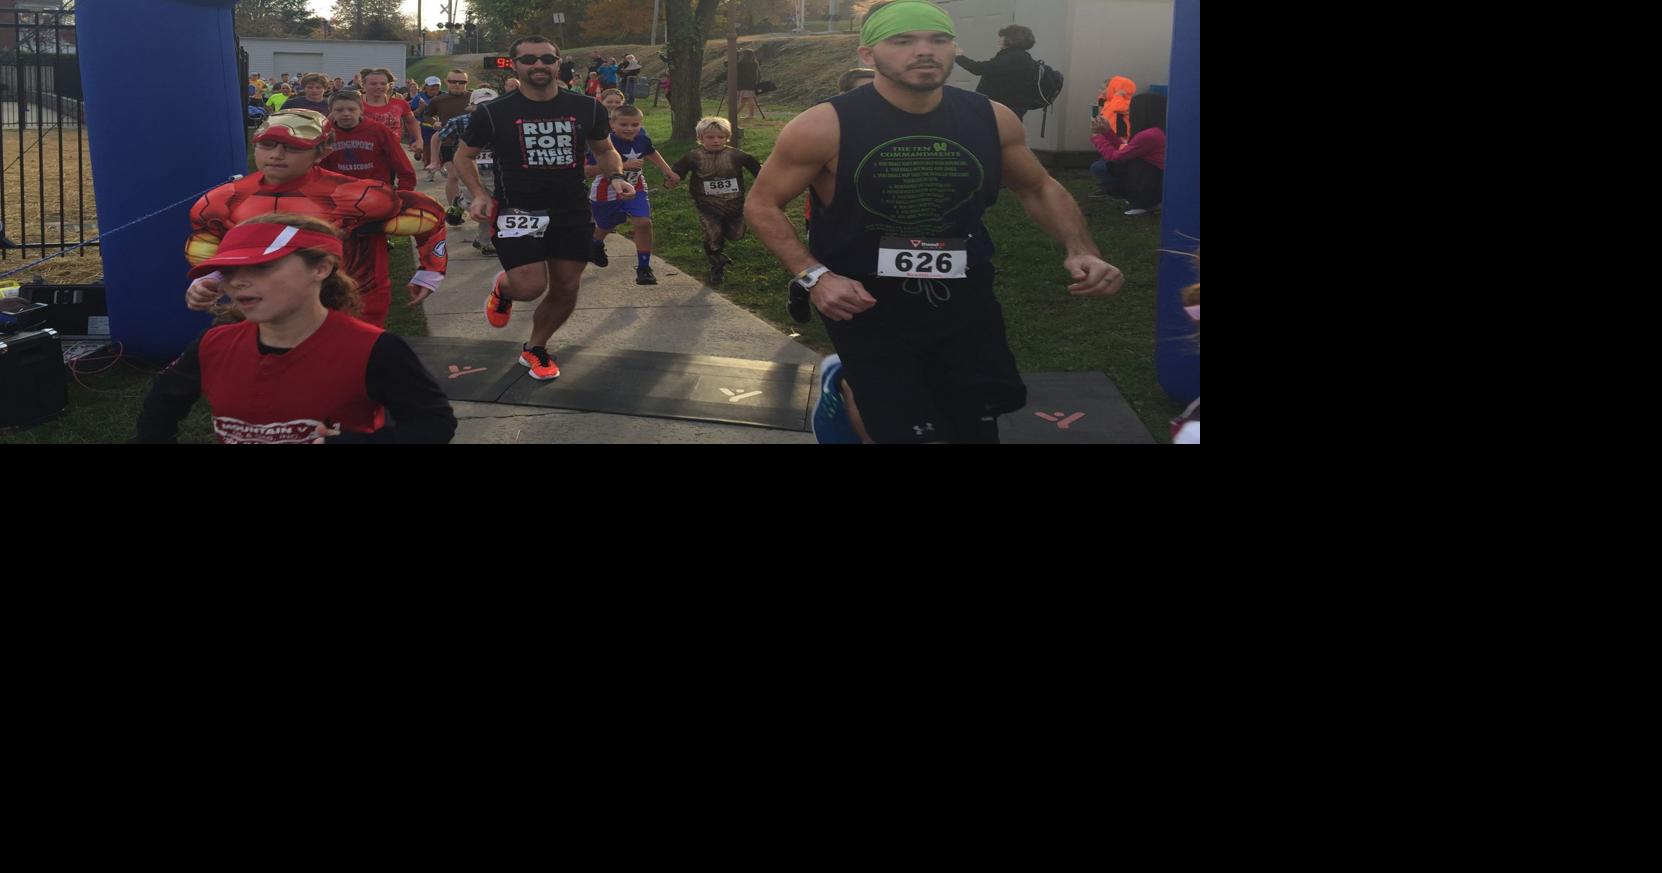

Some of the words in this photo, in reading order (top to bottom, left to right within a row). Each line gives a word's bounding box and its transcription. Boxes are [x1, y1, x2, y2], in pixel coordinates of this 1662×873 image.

[522, 121, 572, 135] RUN
[524, 135, 573, 149] FOR
[527, 147, 573, 157] THEIR
[527, 155, 574, 166] LIVES
[709, 180, 732, 190] 583
[505, 216, 540, 229] 527
[895, 251, 953, 274] 626
[222, 423, 292, 435] MOUNTAIN
